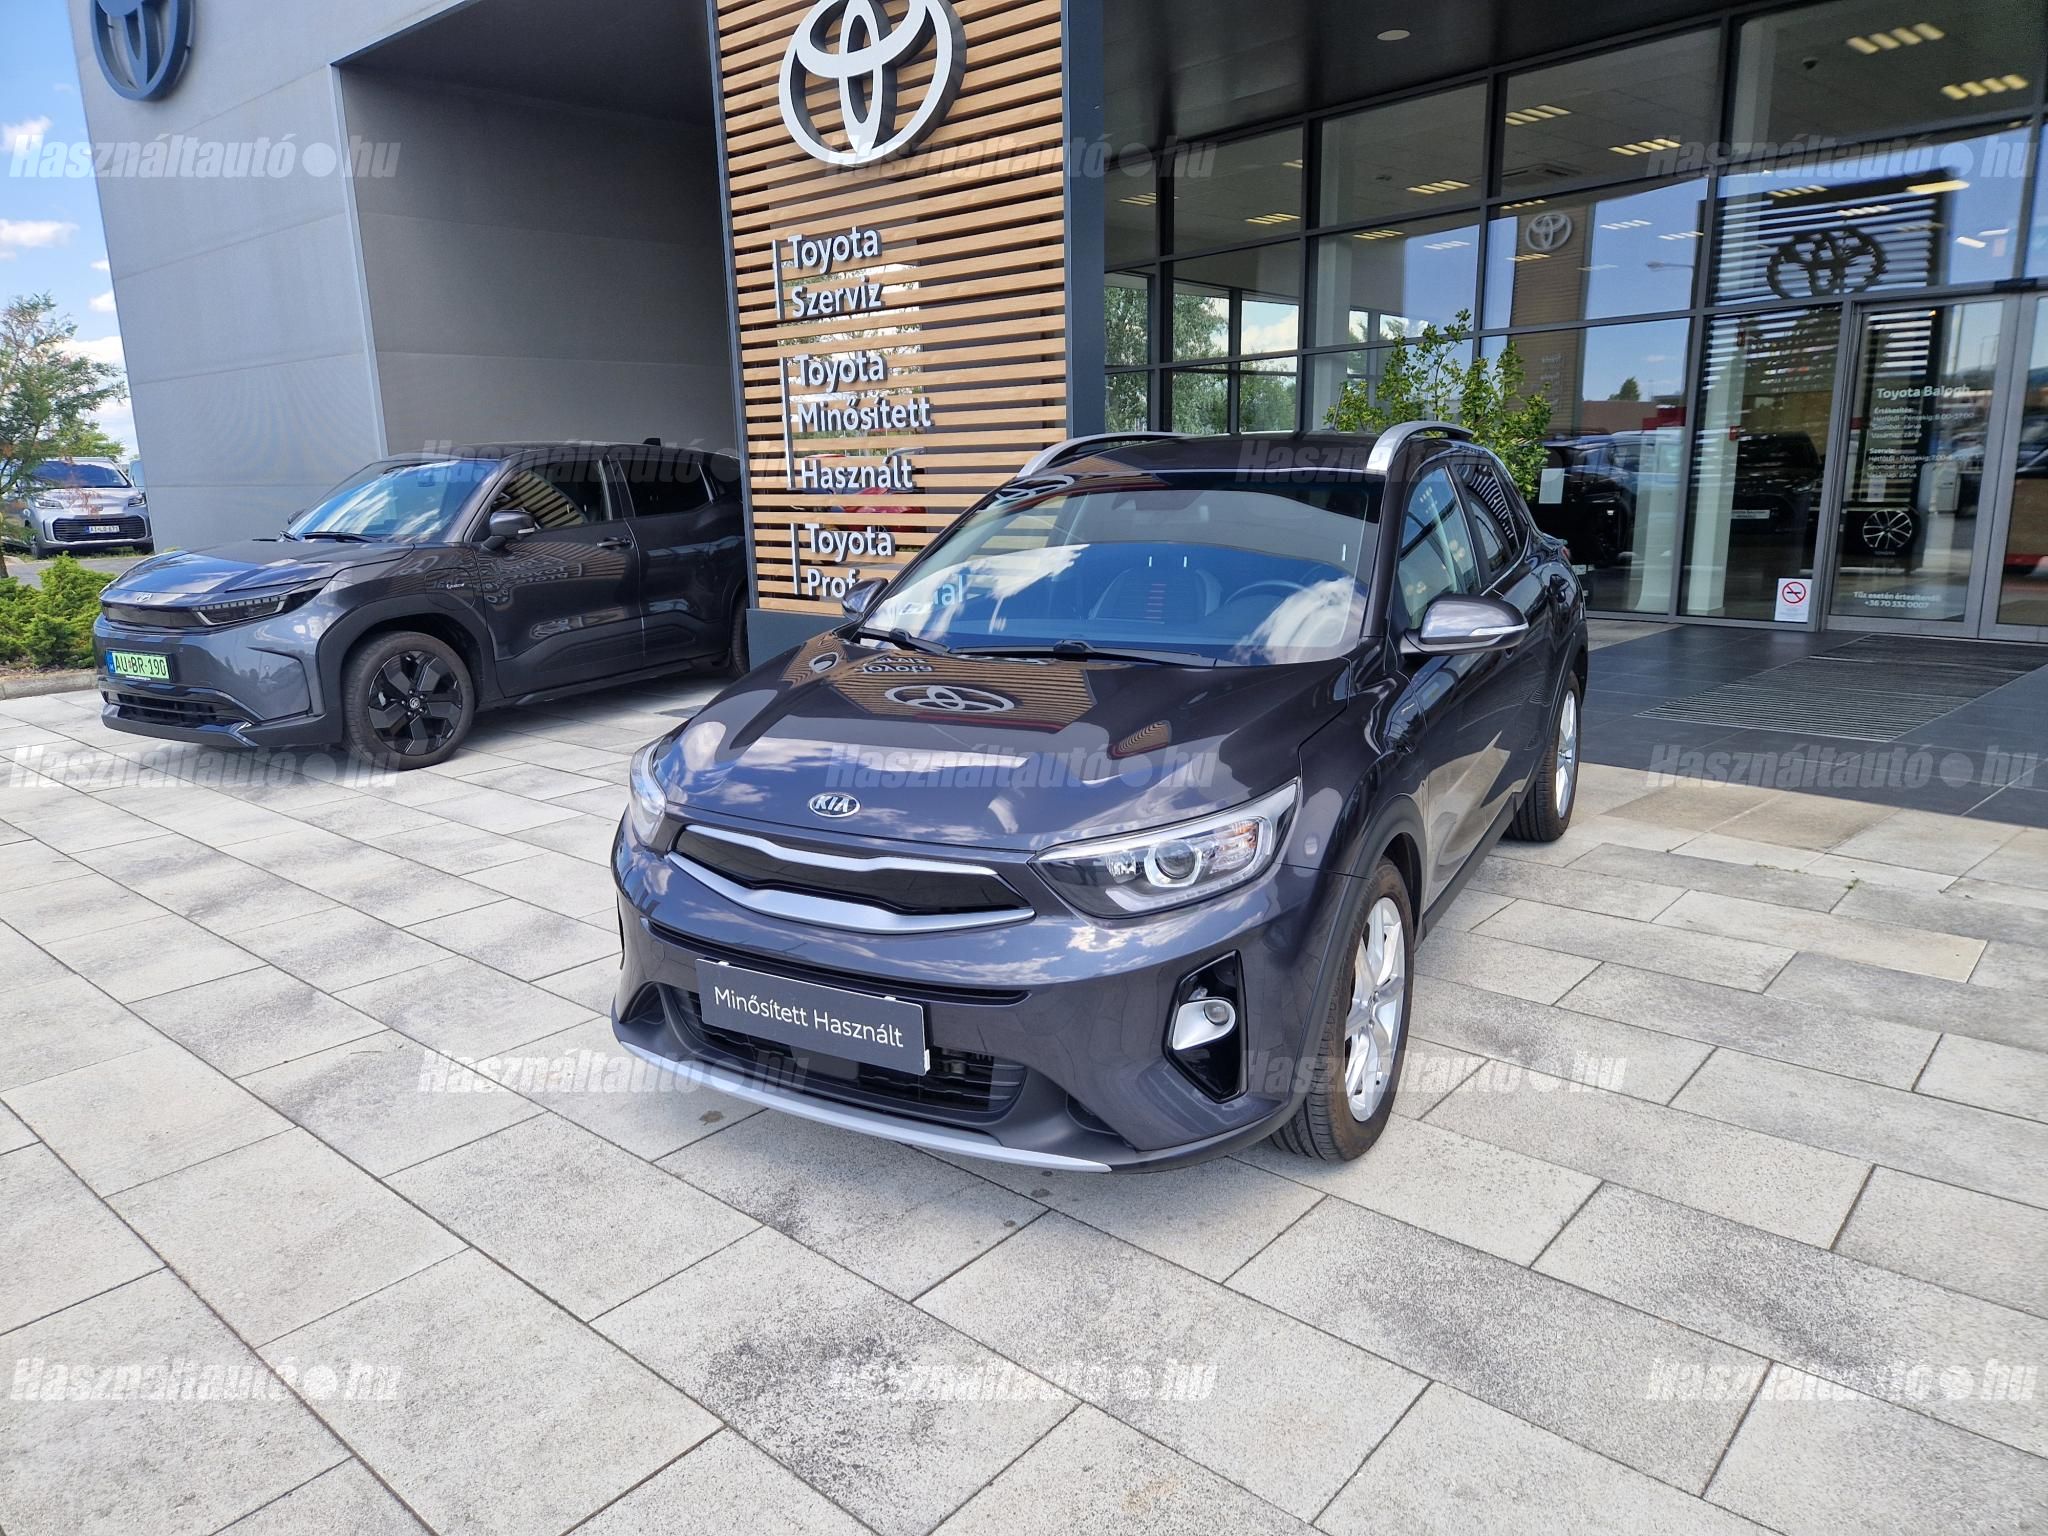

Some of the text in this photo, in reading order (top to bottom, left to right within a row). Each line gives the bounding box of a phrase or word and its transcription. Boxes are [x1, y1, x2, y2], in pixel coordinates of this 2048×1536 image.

[788, 224, 881, 273] Toyota
[791, 275, 882, 318] Szerviz
[795, 351, 885, 393] Toyota
[1876, 384, 1970, 400] Toyota Balogh
[797, 394, 932, 433] Minősített
[801, 456, 914, 489] Használt
[805, 522, 893, 563] Toyota
[1868, 592, 1894, 600] esetén
[815, 796, 850, 813] KIA
[714, 985, 904, 1048] Minősített Használt
